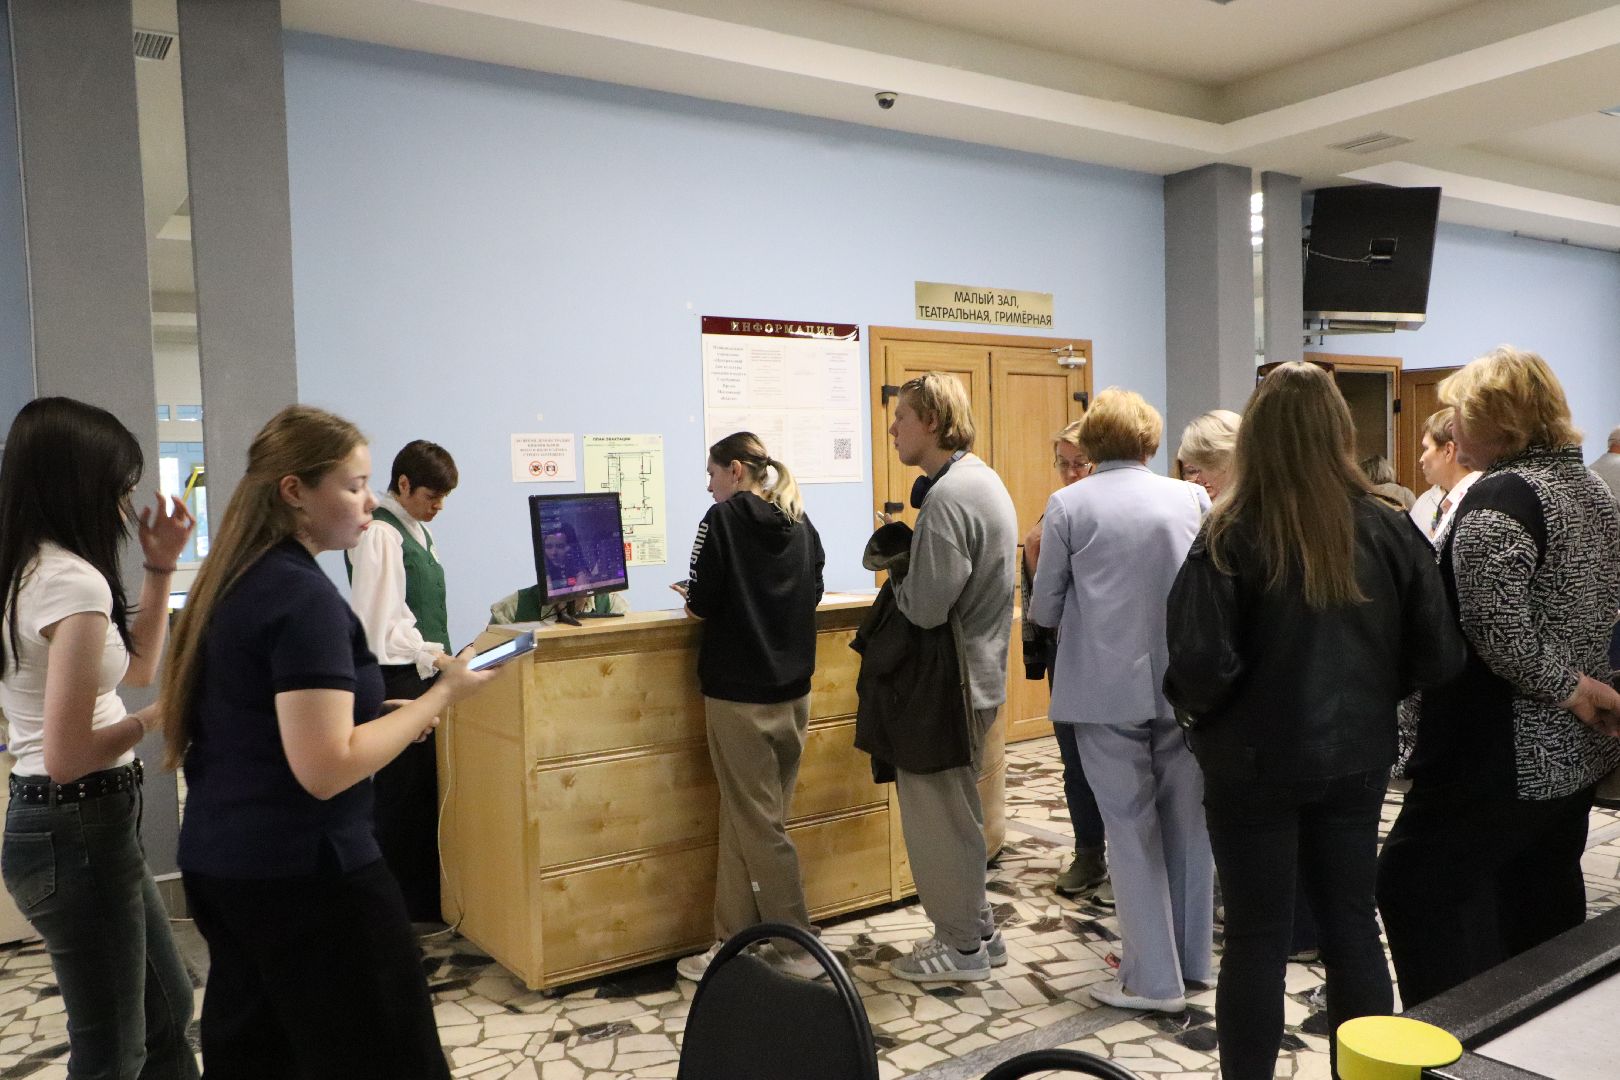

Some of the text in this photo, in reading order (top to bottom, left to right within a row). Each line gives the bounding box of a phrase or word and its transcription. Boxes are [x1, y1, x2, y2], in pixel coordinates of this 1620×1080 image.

[954, 290, 1019, 309] МАЛЫЙ ЗАЛ,
[918, 305, 1052, 326] ТЕАТРАЛЬНАЯ, ГРИМЁРНАЯ
[731, 321, 835, 336] ИНФОРМАЦИЯ
